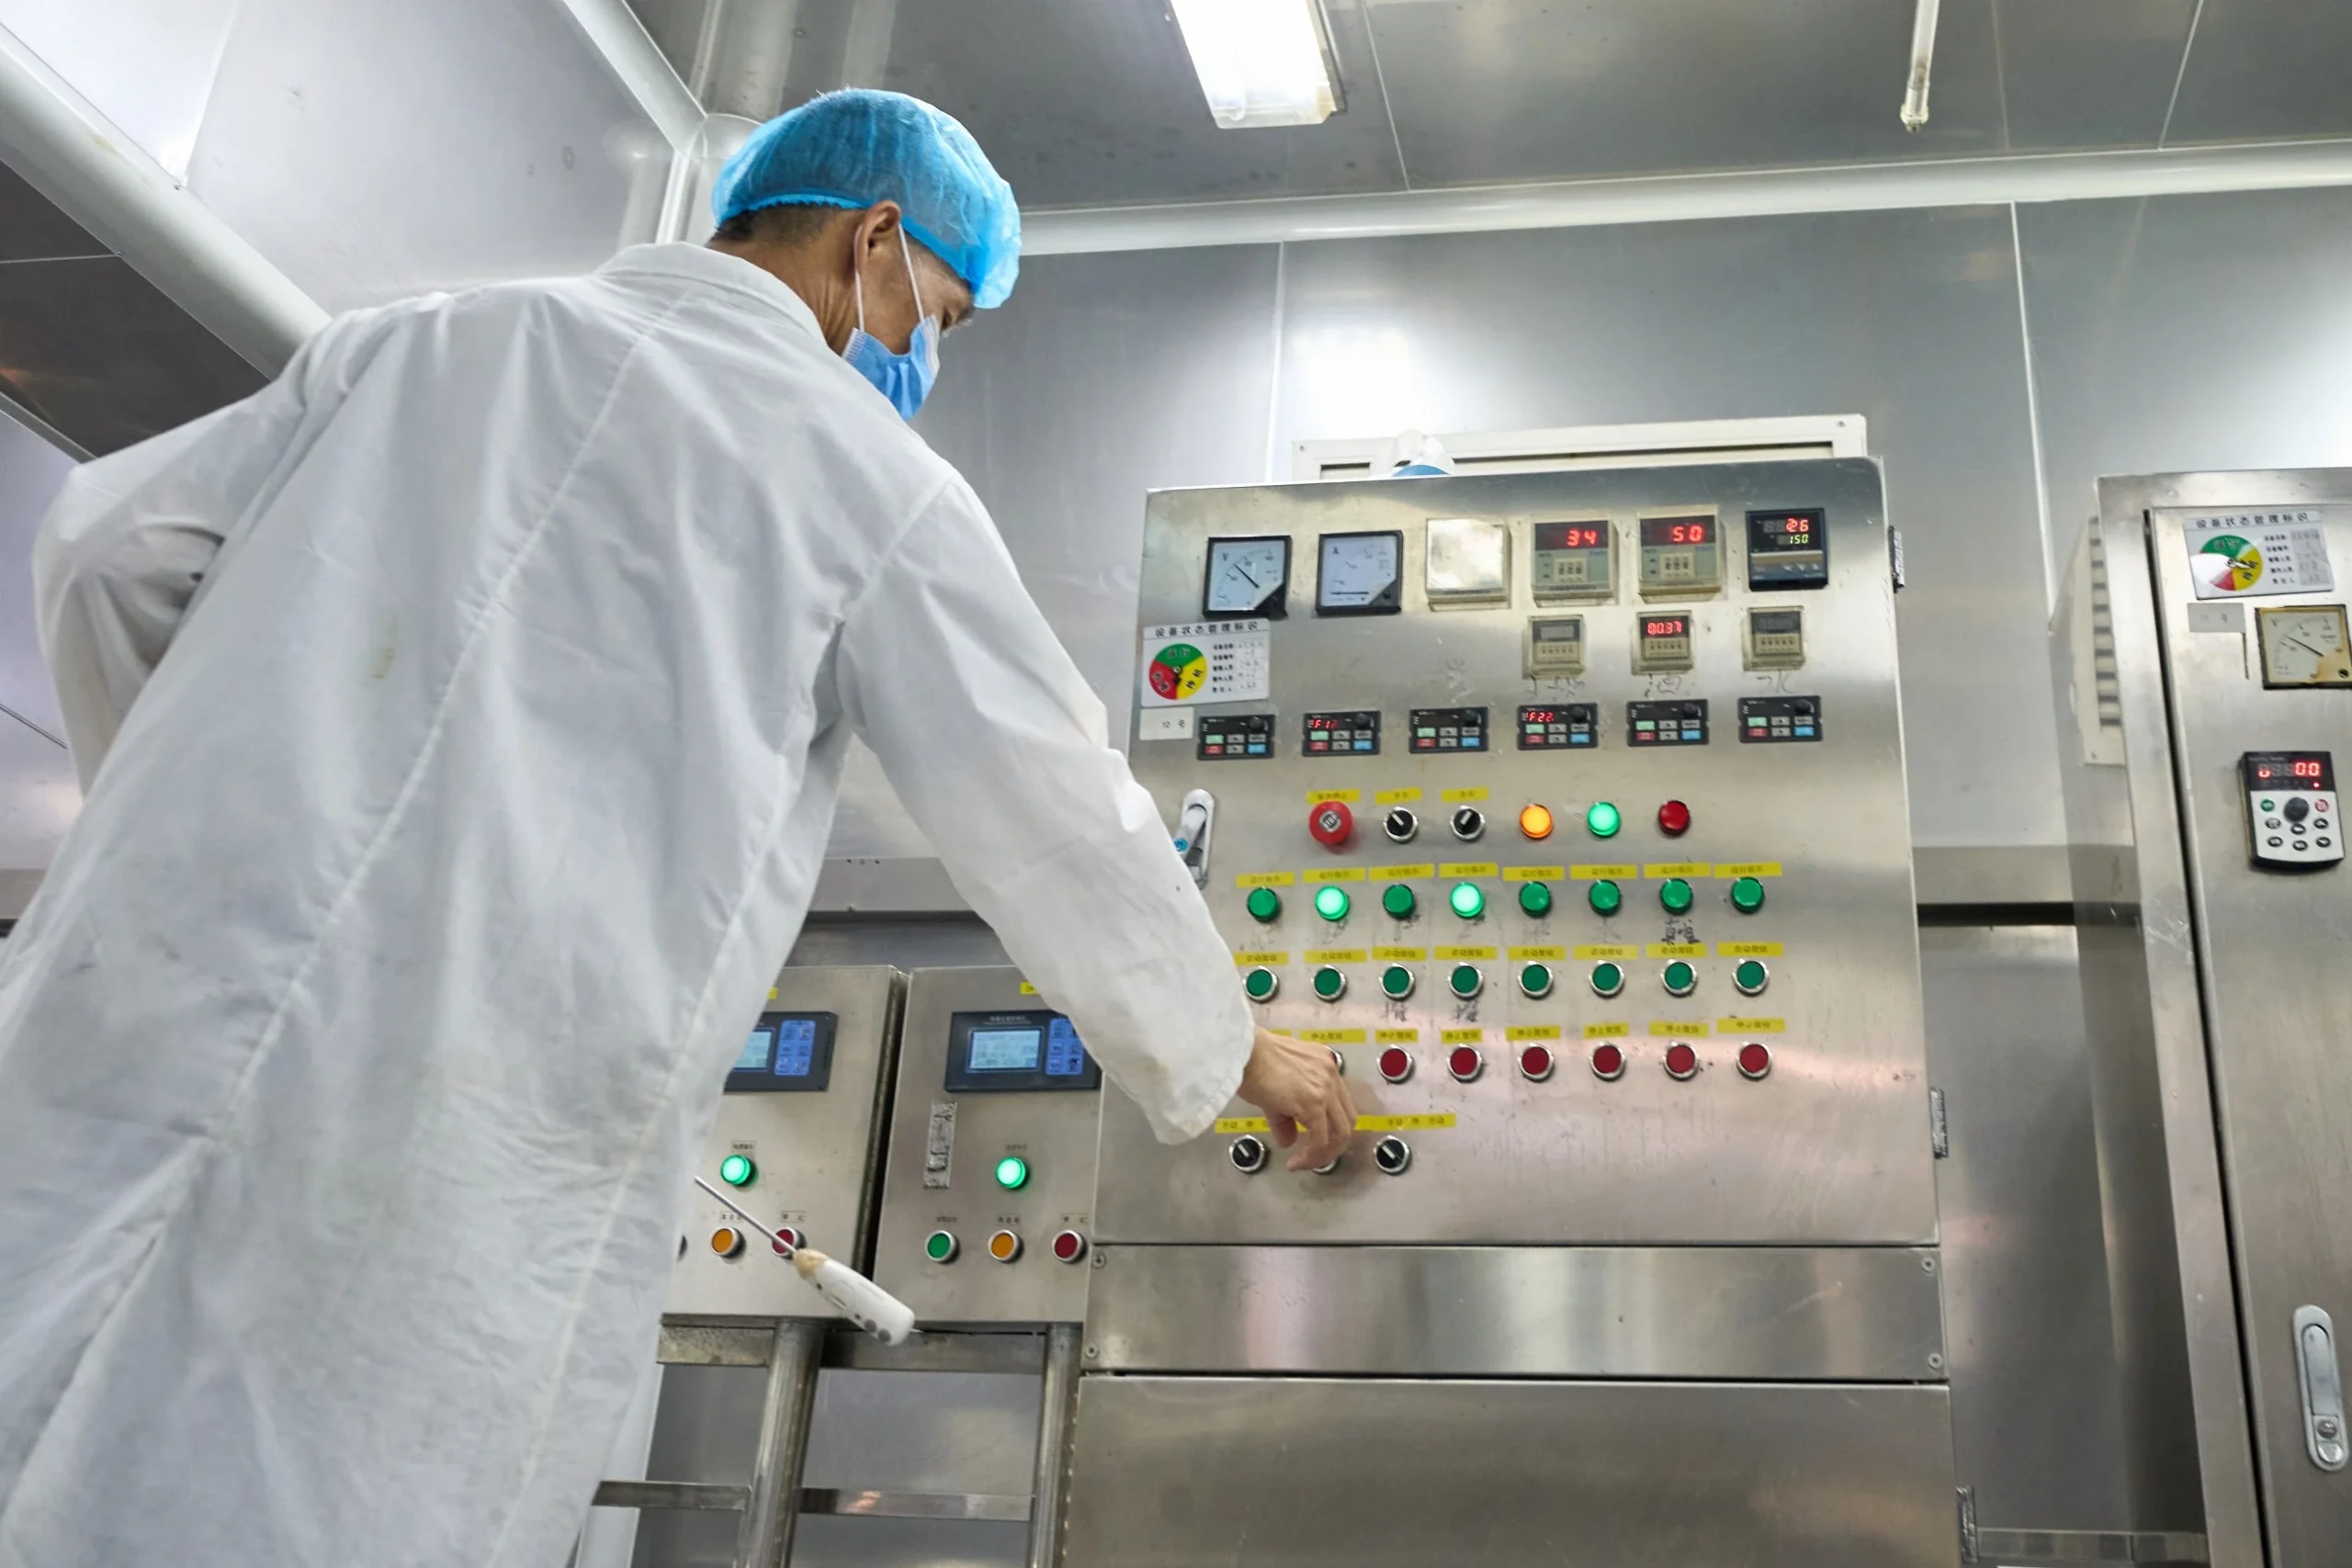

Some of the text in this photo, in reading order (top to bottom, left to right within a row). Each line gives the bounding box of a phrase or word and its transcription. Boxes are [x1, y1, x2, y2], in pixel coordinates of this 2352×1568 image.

[1672, 525, 1703, 542] 50
[1785, 518, 1809, 533] 26
[1566, 528, 1597, 547] 34
[1790, 534, 1809, 544] 150
[1155, 621, 1258, 637] 设备状态管理标识
